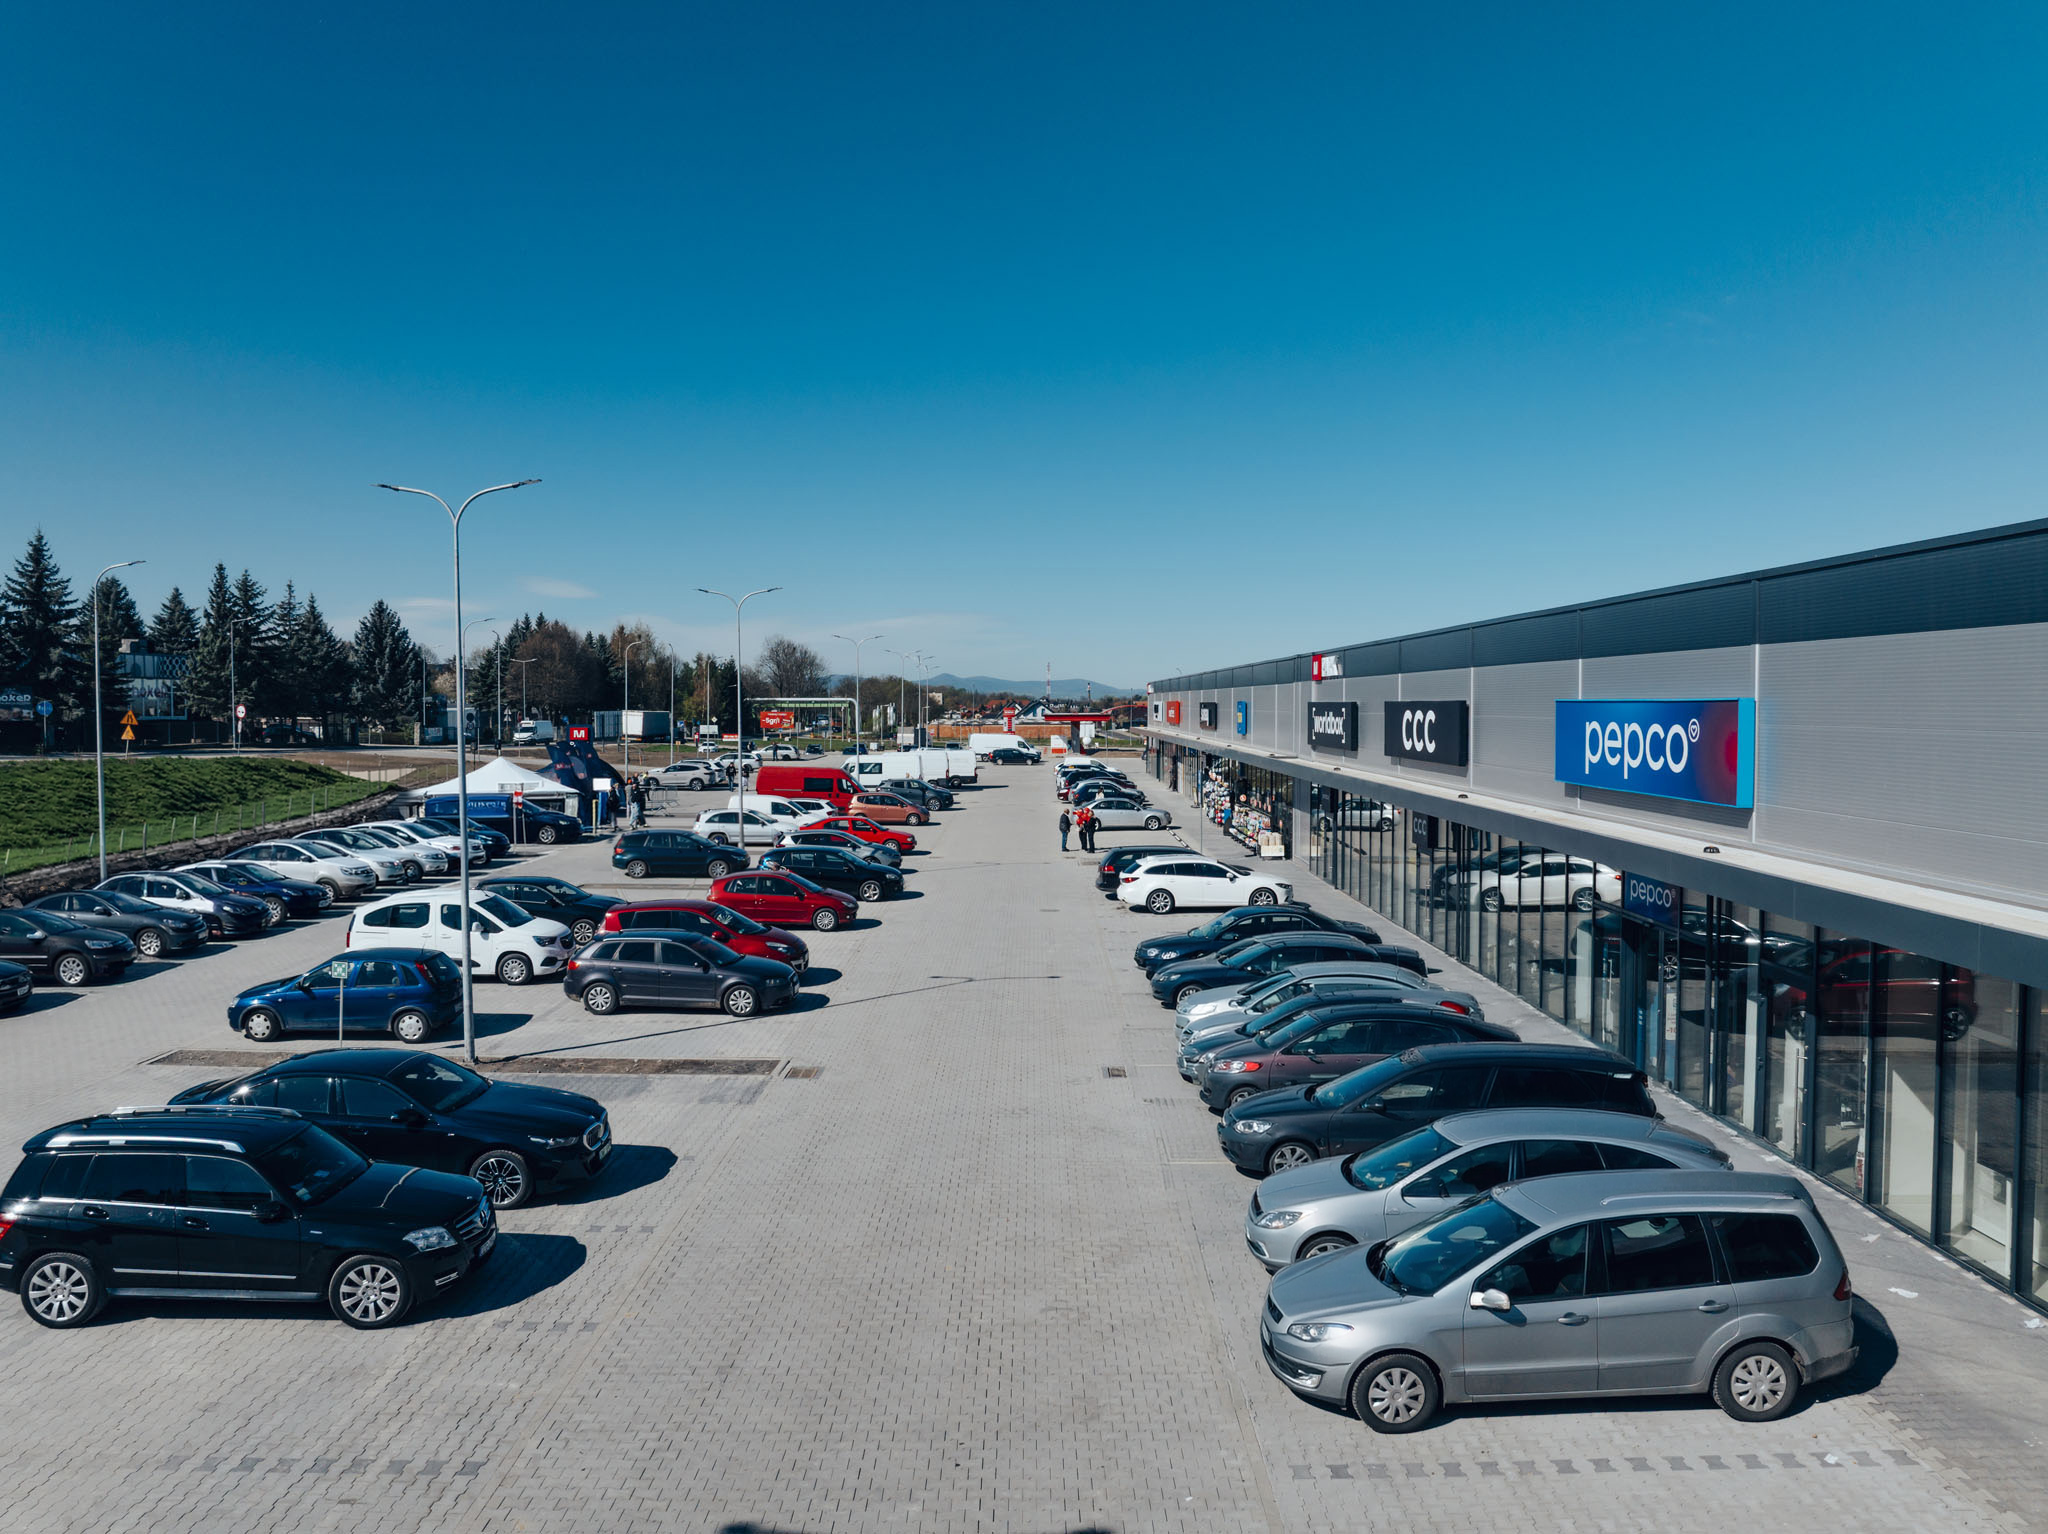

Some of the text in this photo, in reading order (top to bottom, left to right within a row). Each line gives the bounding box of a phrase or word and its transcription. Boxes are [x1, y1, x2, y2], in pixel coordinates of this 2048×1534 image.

[573, 729, 585, 738] M
[1312, 711, 1345, 735] worldbox
[1402, 709, 1436, 753] CCC
[1585, 720, 1689, 779] pepco
[1413, 817, 1427, 835] CCC
[1630, 878, 1672, 908] pepco
